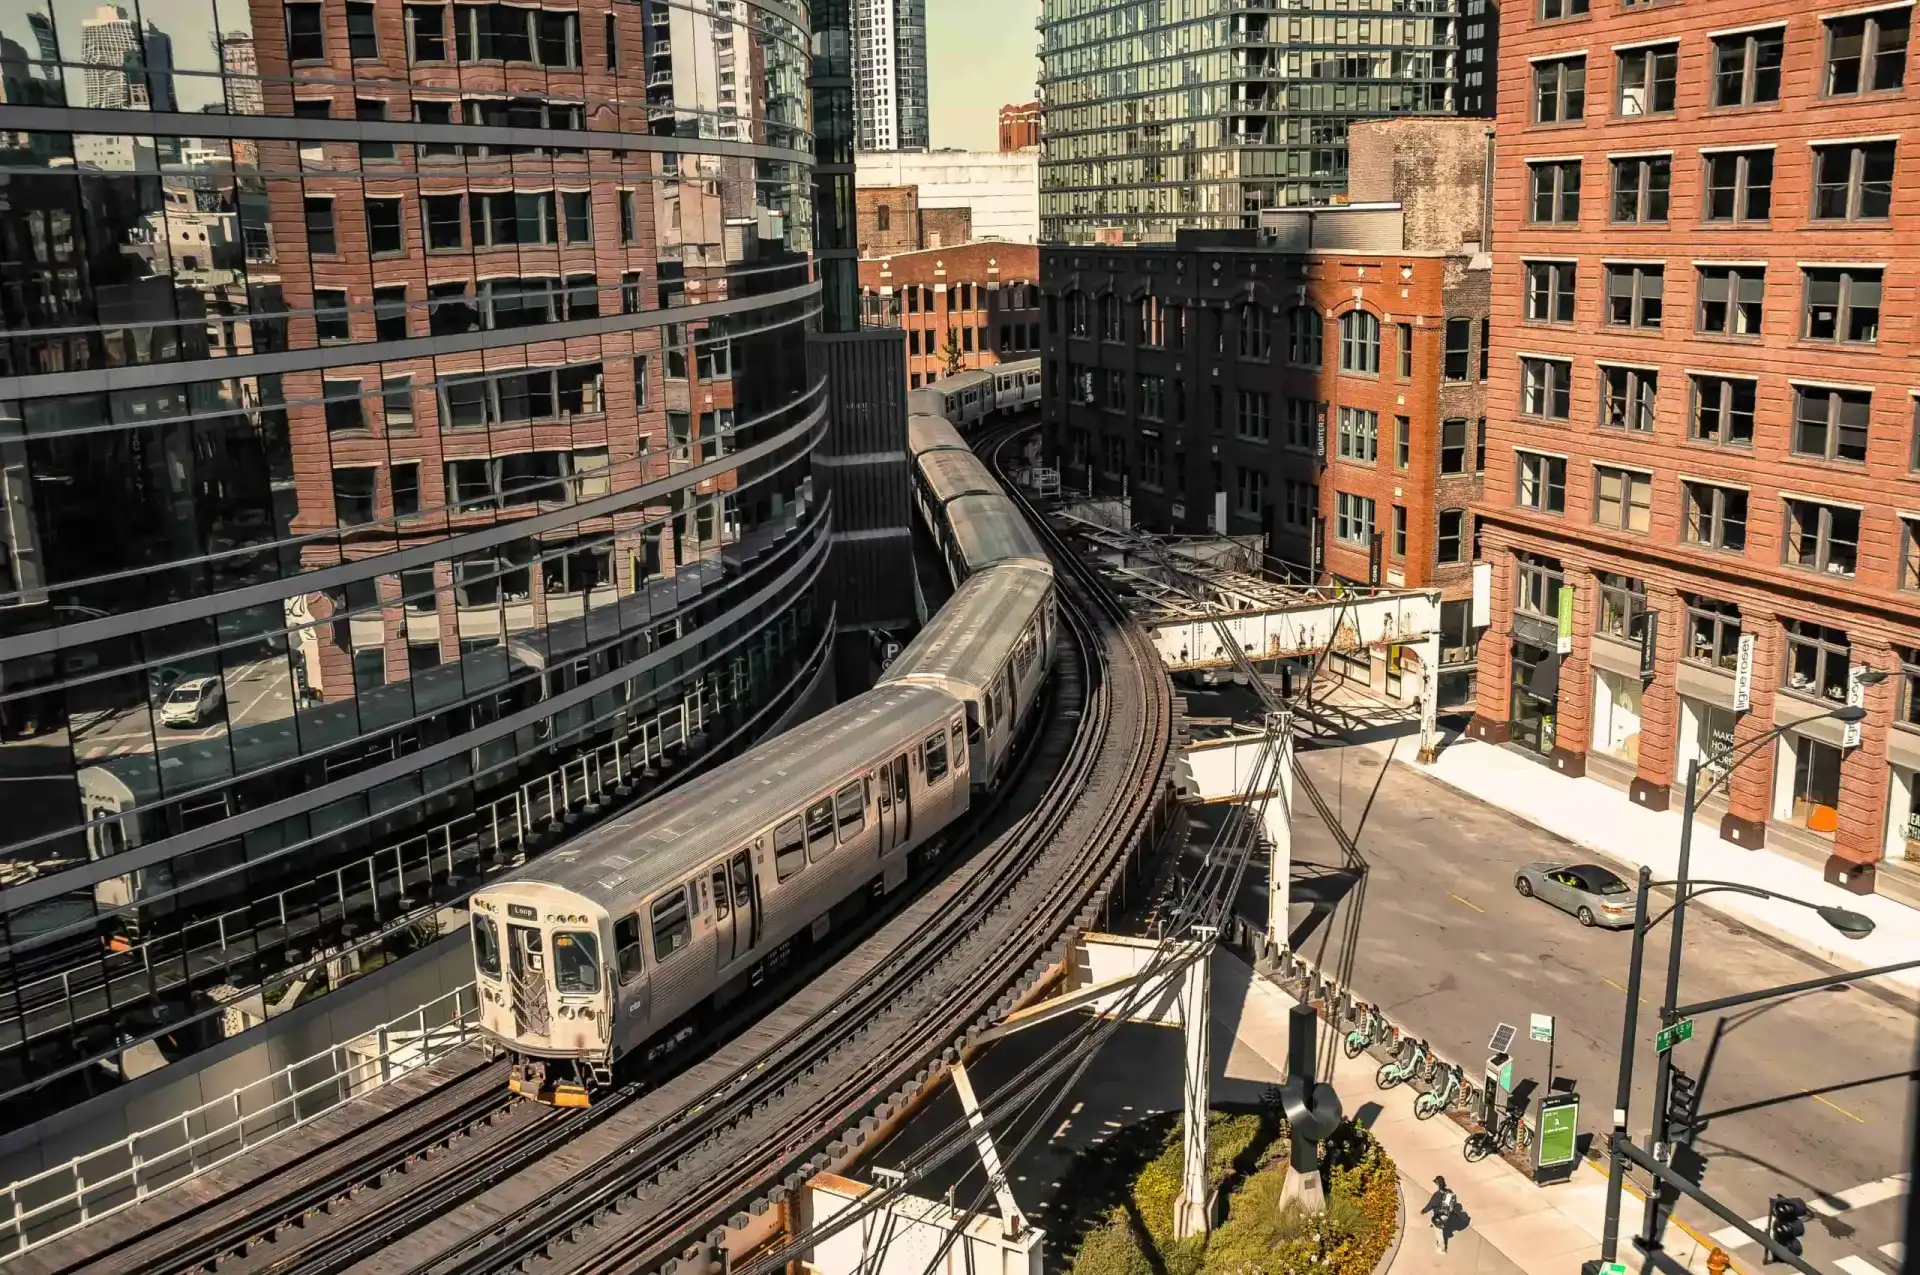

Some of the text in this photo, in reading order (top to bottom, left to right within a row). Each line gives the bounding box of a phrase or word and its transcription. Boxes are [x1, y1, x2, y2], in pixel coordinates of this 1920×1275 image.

[887, 643, 899, 659] P
[1736, 638, 1750, 709] ligne roset
[1713, 729, 1735, 744] MAKE
[514, 905, 533, 917] Loop
